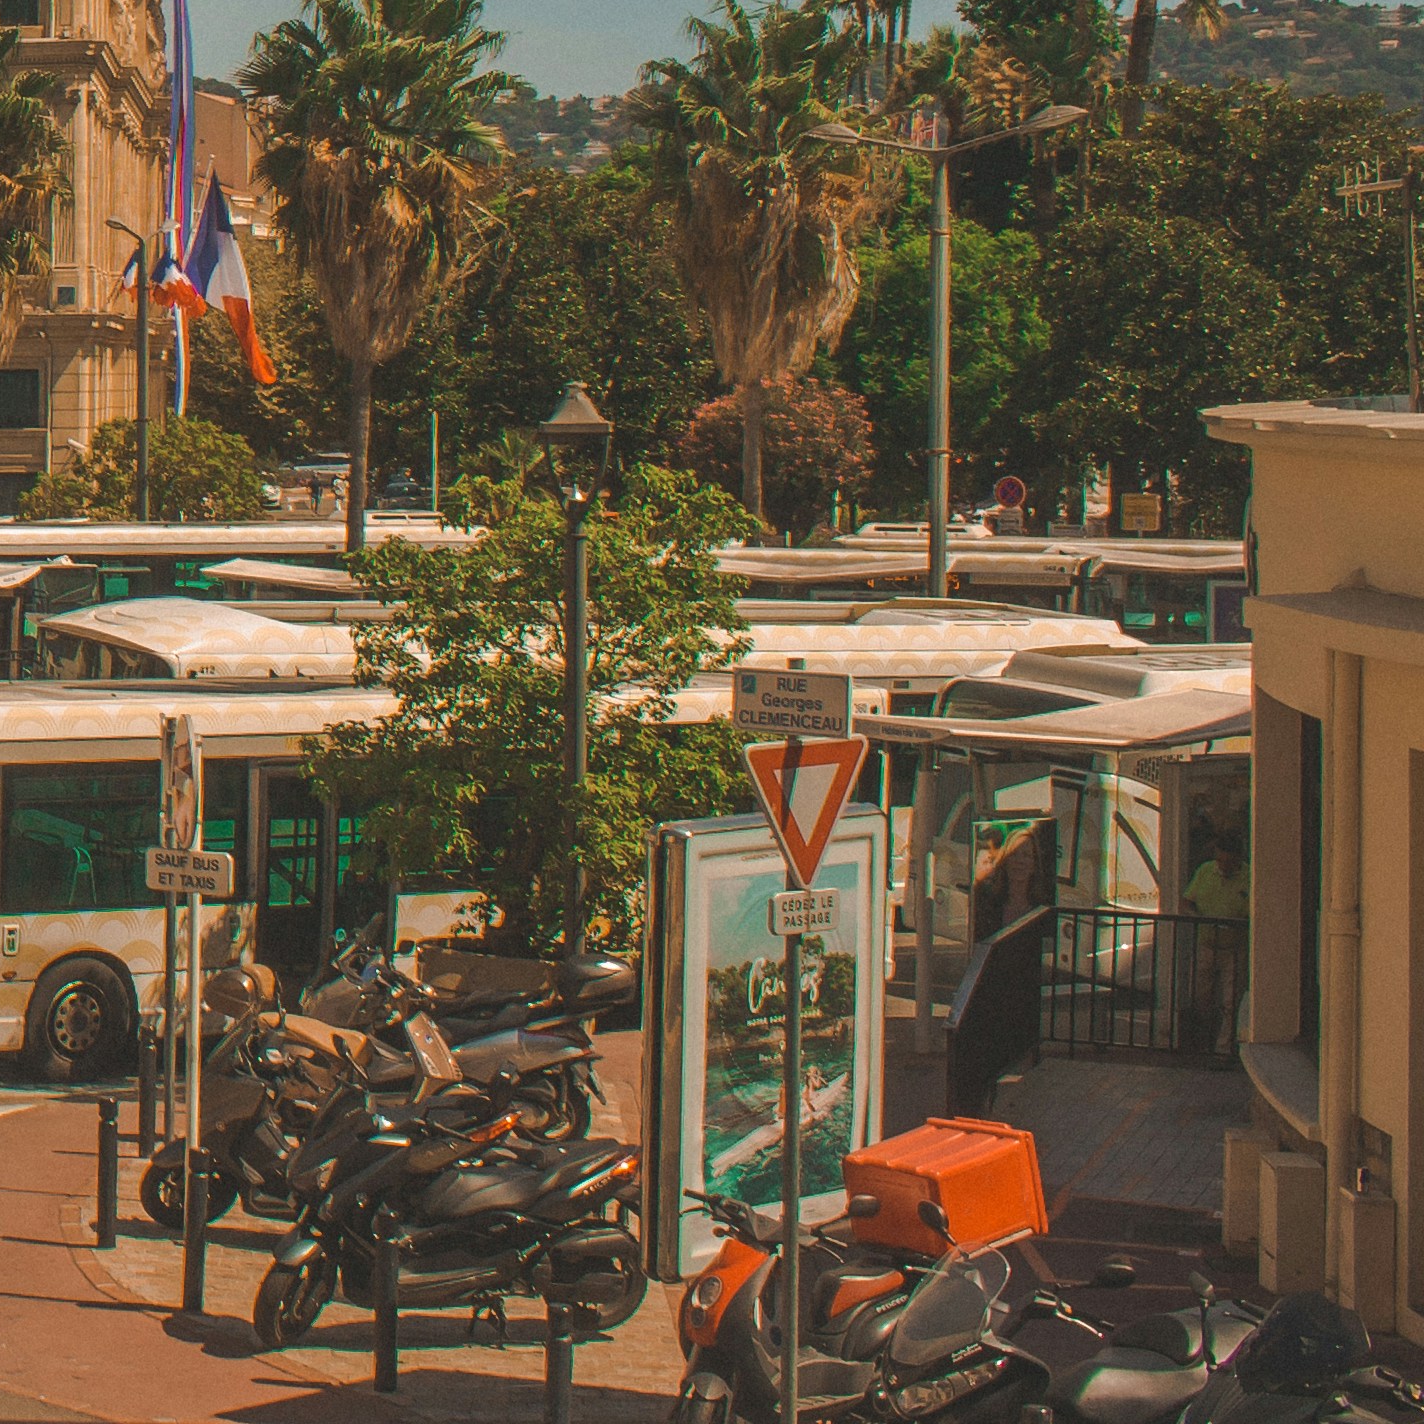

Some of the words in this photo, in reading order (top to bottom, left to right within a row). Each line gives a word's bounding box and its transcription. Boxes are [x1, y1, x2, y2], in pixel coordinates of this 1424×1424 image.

[777, 676, 807, 693] RUE
[761, 693, 823, 712] Georges
[738, 709, 843, 732] CLEMENCEAU
[155, 853, 188, 868] SAUF
[193, 857, 219, 872] BUS
[159, 872, 174, 885] ET
[180, 874, 215, 890] TAXIS
[820, 895, 834, 909] LE
[783, 911, 831, 928] PASSAGE
